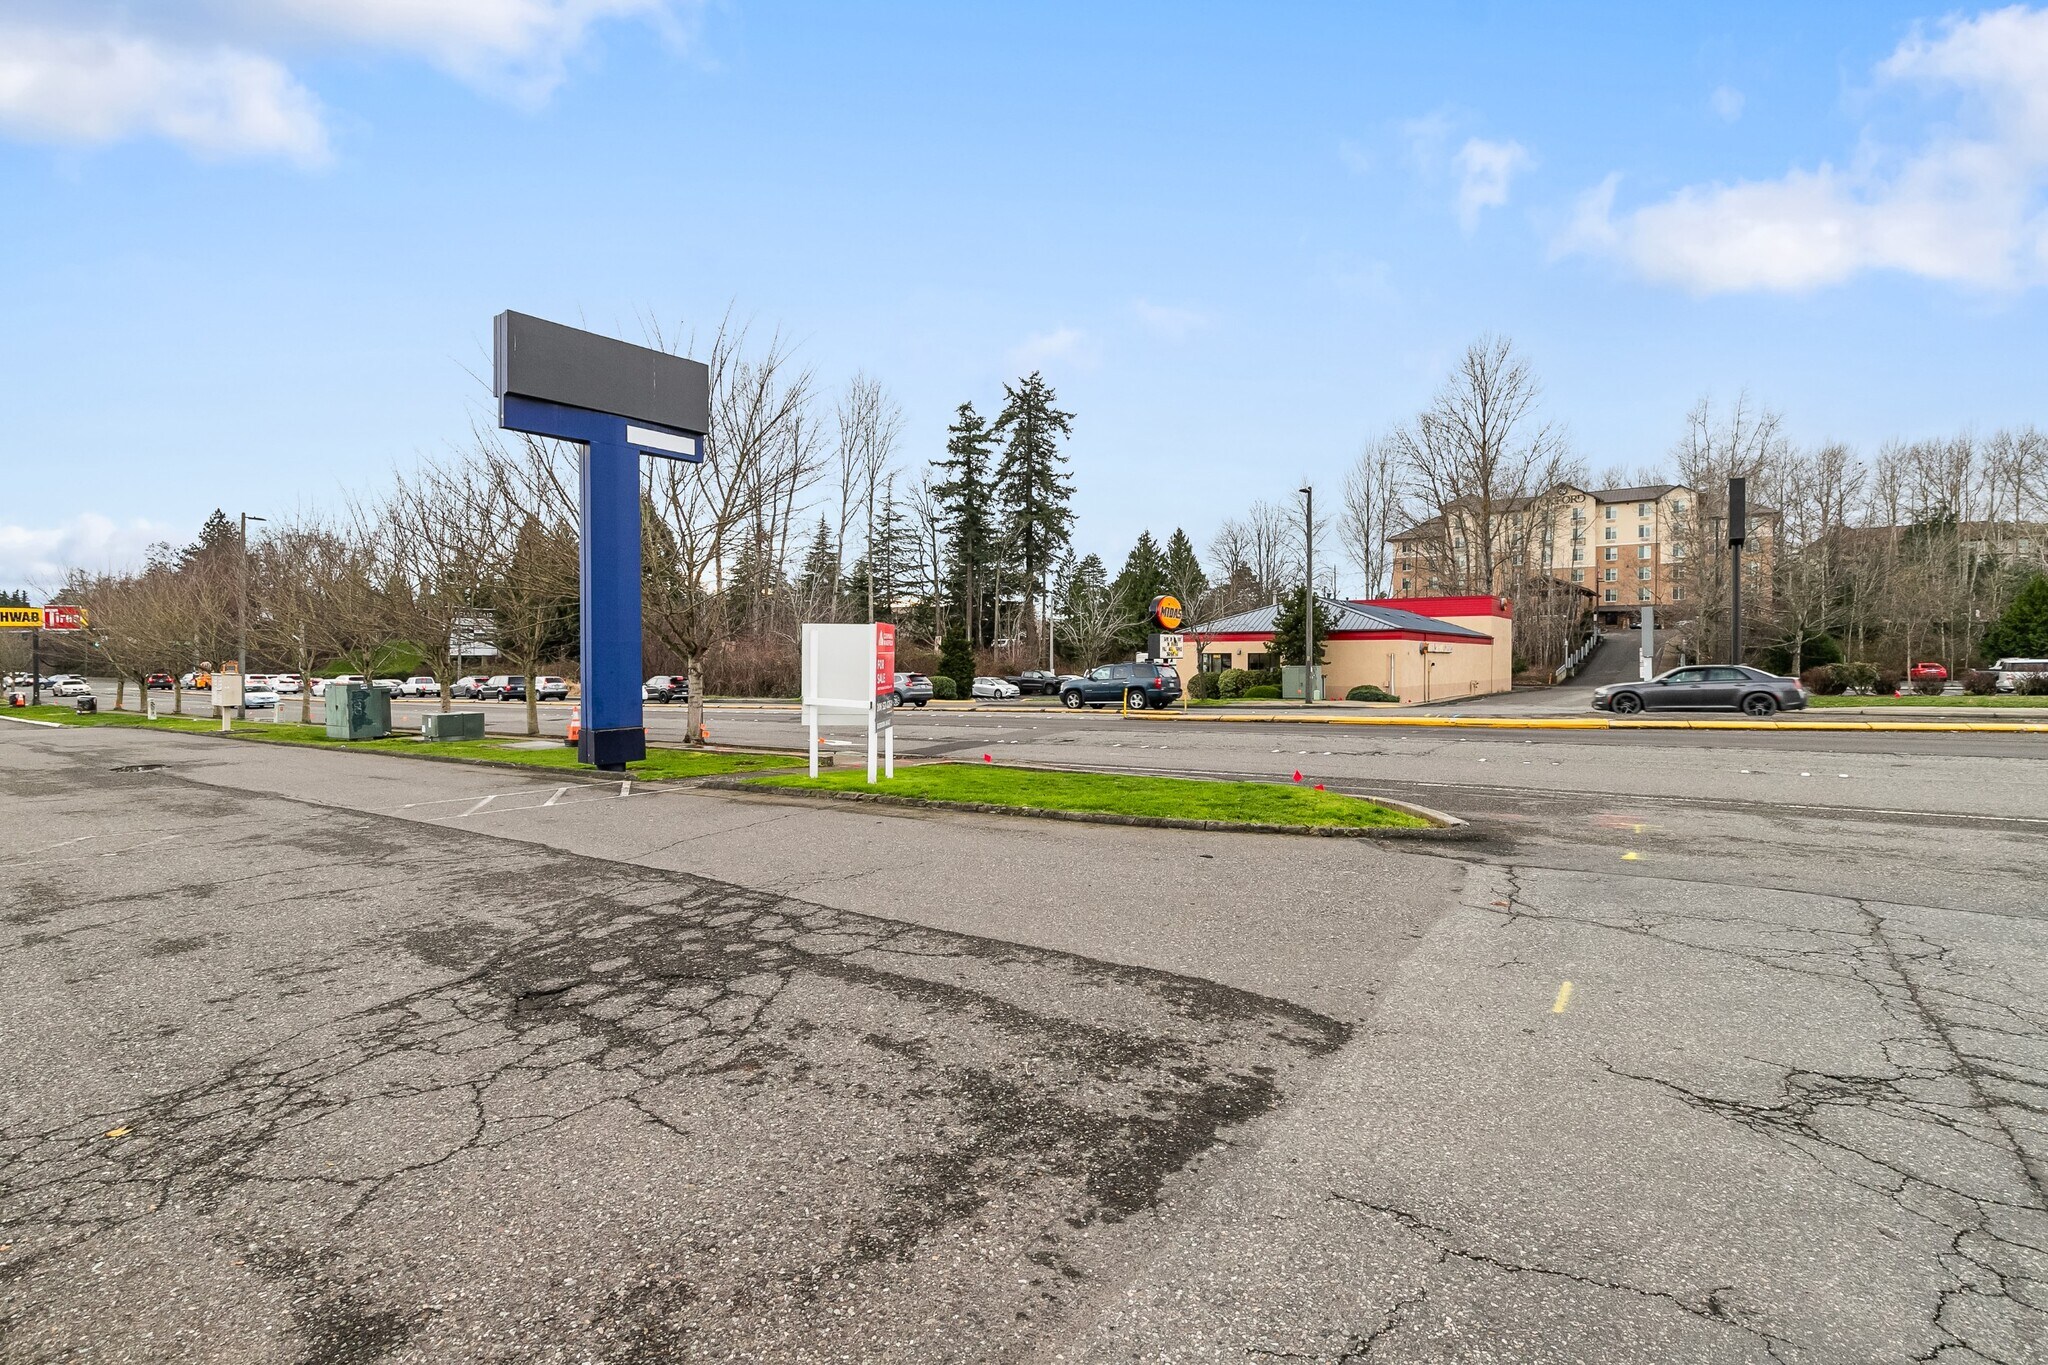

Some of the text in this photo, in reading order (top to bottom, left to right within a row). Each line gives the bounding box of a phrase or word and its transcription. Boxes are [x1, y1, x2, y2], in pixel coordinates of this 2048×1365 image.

[1540, 494, 1586, 506] OFORD
[1161, 606, 1182, 619] MIDAS
[877, 659, 885, 670] FOR
[877, 672, 886, 684] SALE
